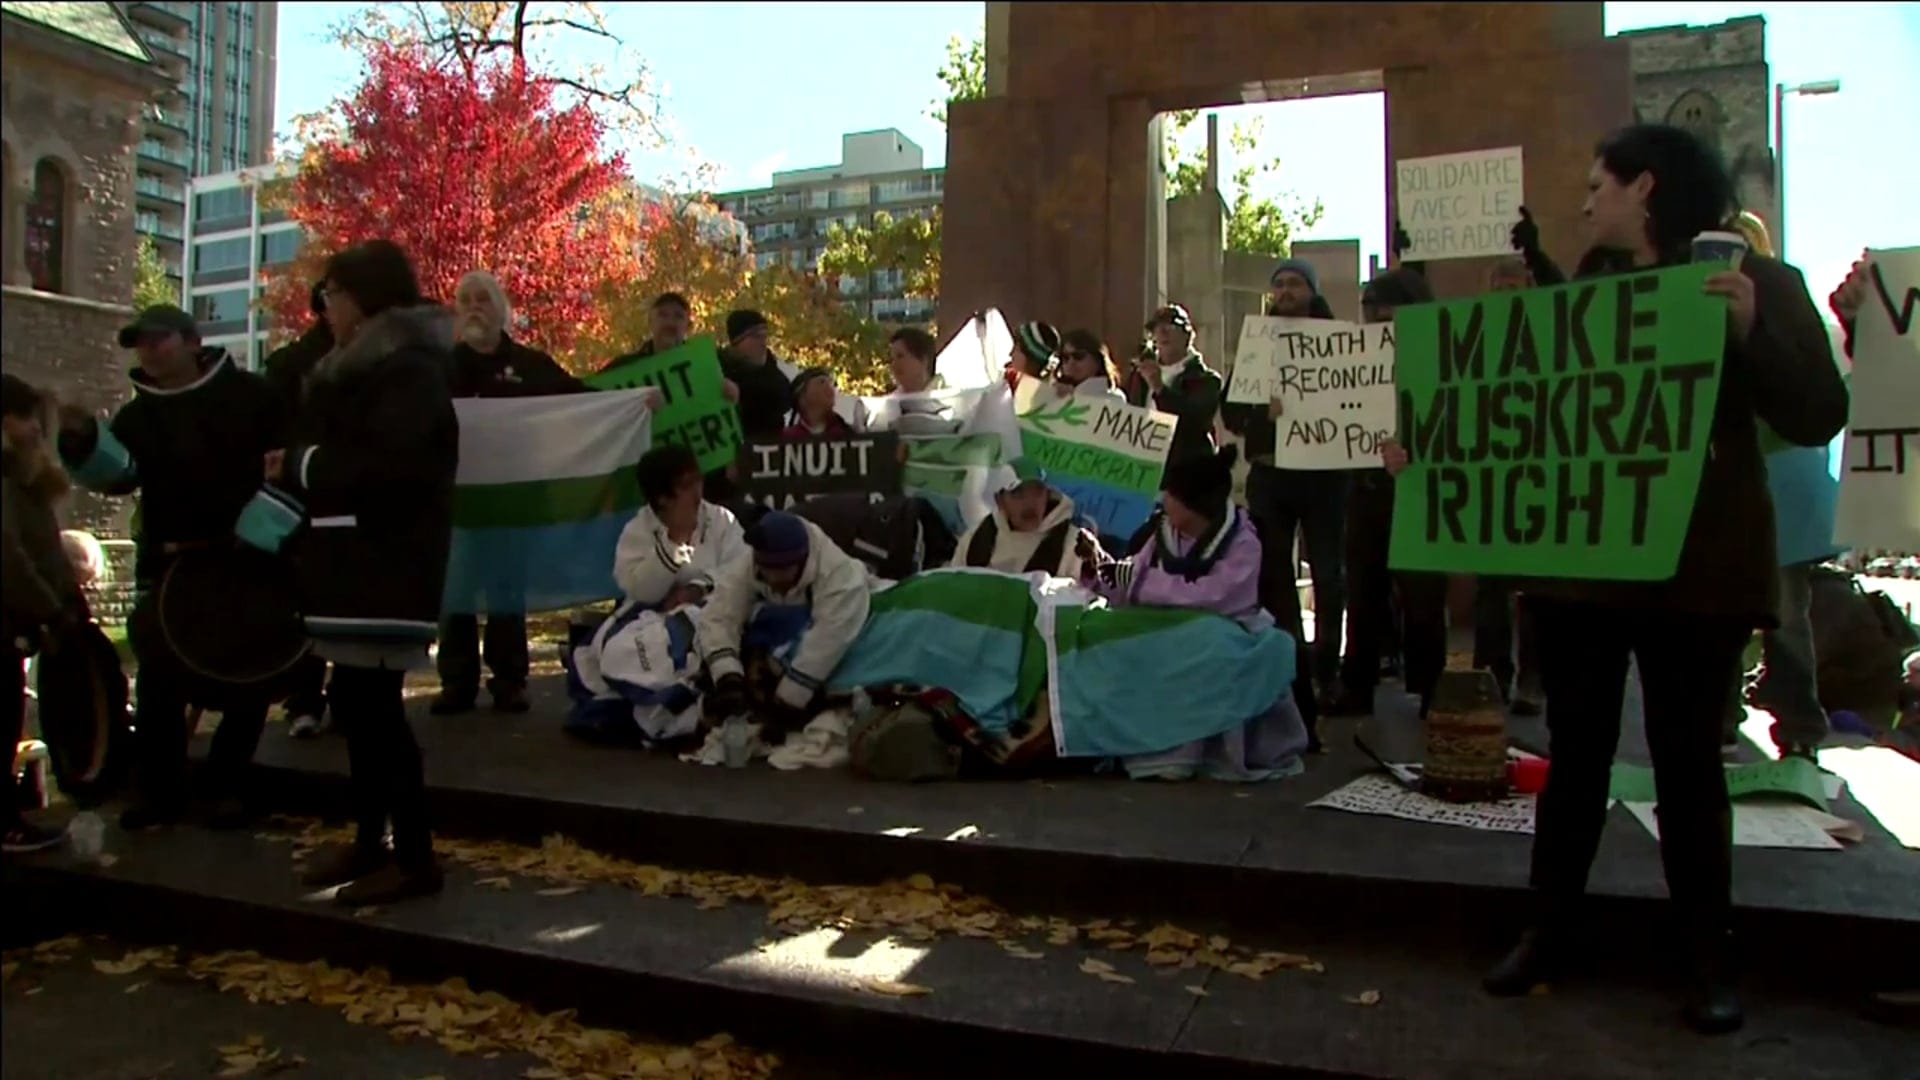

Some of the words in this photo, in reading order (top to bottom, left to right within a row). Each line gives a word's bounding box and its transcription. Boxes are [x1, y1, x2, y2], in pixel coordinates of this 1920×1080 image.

[1400, 156, 1519, 193] SOLIDAIRE
[1411, 193, 1469, 222] AVEC
[1481, 189, 1510, 217] LE
[1403, 222, 1515, 255] ABRADO
[1279, 328, 1365, 360] TRUTH
[1438, 275, 1660, 383] MAKE
[1093, 405, 1170, 452] MAKE
[1286, 417, 1338, 447] AND
[1400, 360, 1716, 464] MUSKRAT
[751, 439, 875, 479] INUIT
[1040, 438, 1158, 488] MUSKRAT
[1425, 457, 1669, 547] RIGHT
